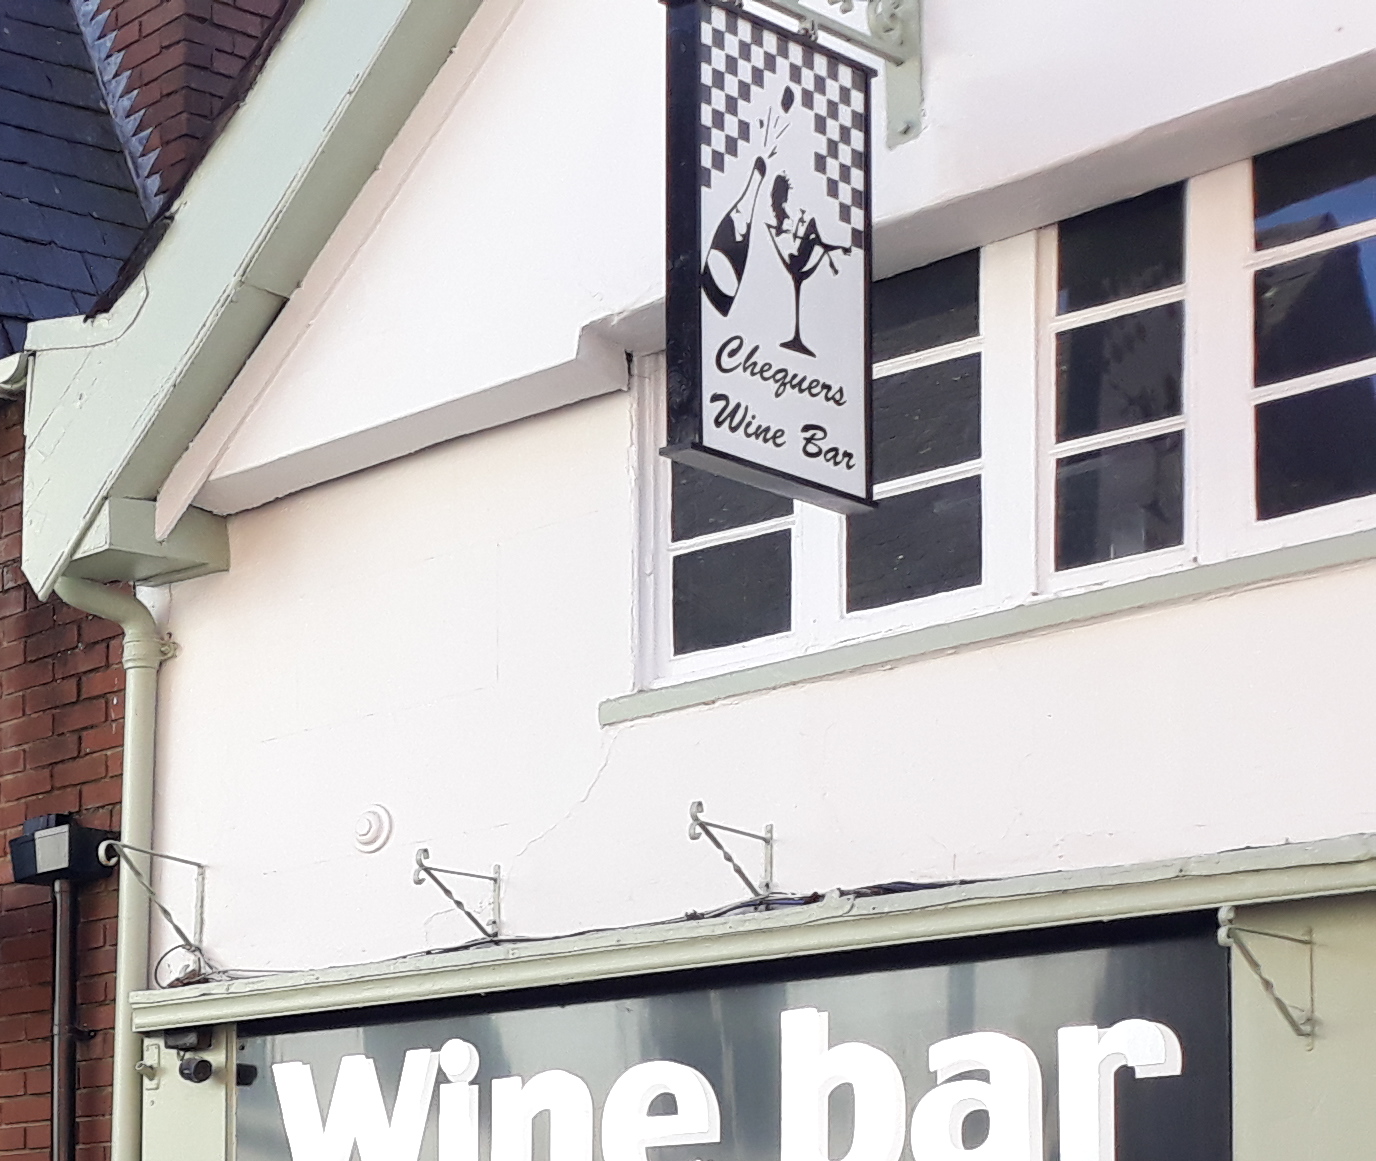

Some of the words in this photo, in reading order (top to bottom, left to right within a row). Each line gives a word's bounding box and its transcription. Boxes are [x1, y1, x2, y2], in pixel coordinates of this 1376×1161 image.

[715, 335, 847, 406] Chequers
[709, 392, 787, 448] Wine
[800, 424, 856, 470] Bar
